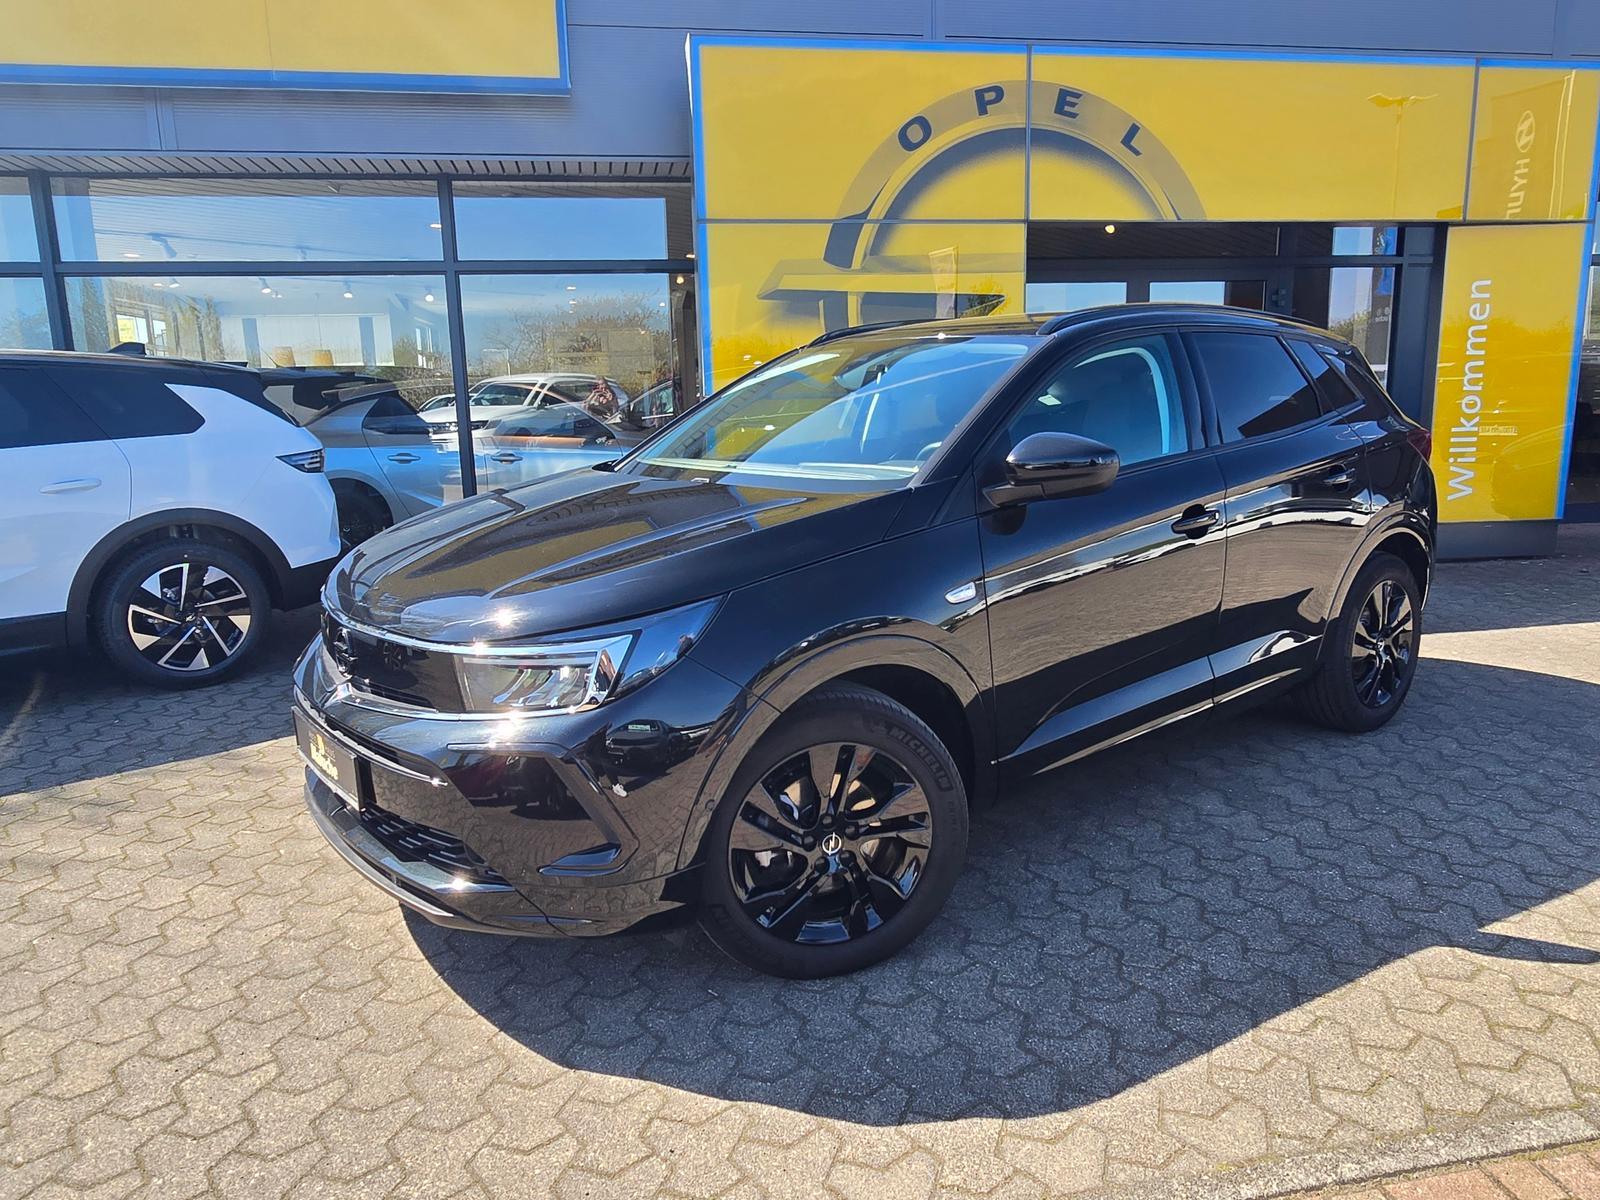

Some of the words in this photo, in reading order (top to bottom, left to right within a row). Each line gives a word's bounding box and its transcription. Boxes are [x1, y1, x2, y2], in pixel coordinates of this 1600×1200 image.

[898, 85, 1143, 156] OPEL
[1447, 278, 1492, 501] Willkommen
[889, 727, 951, 790] MICHELIN
